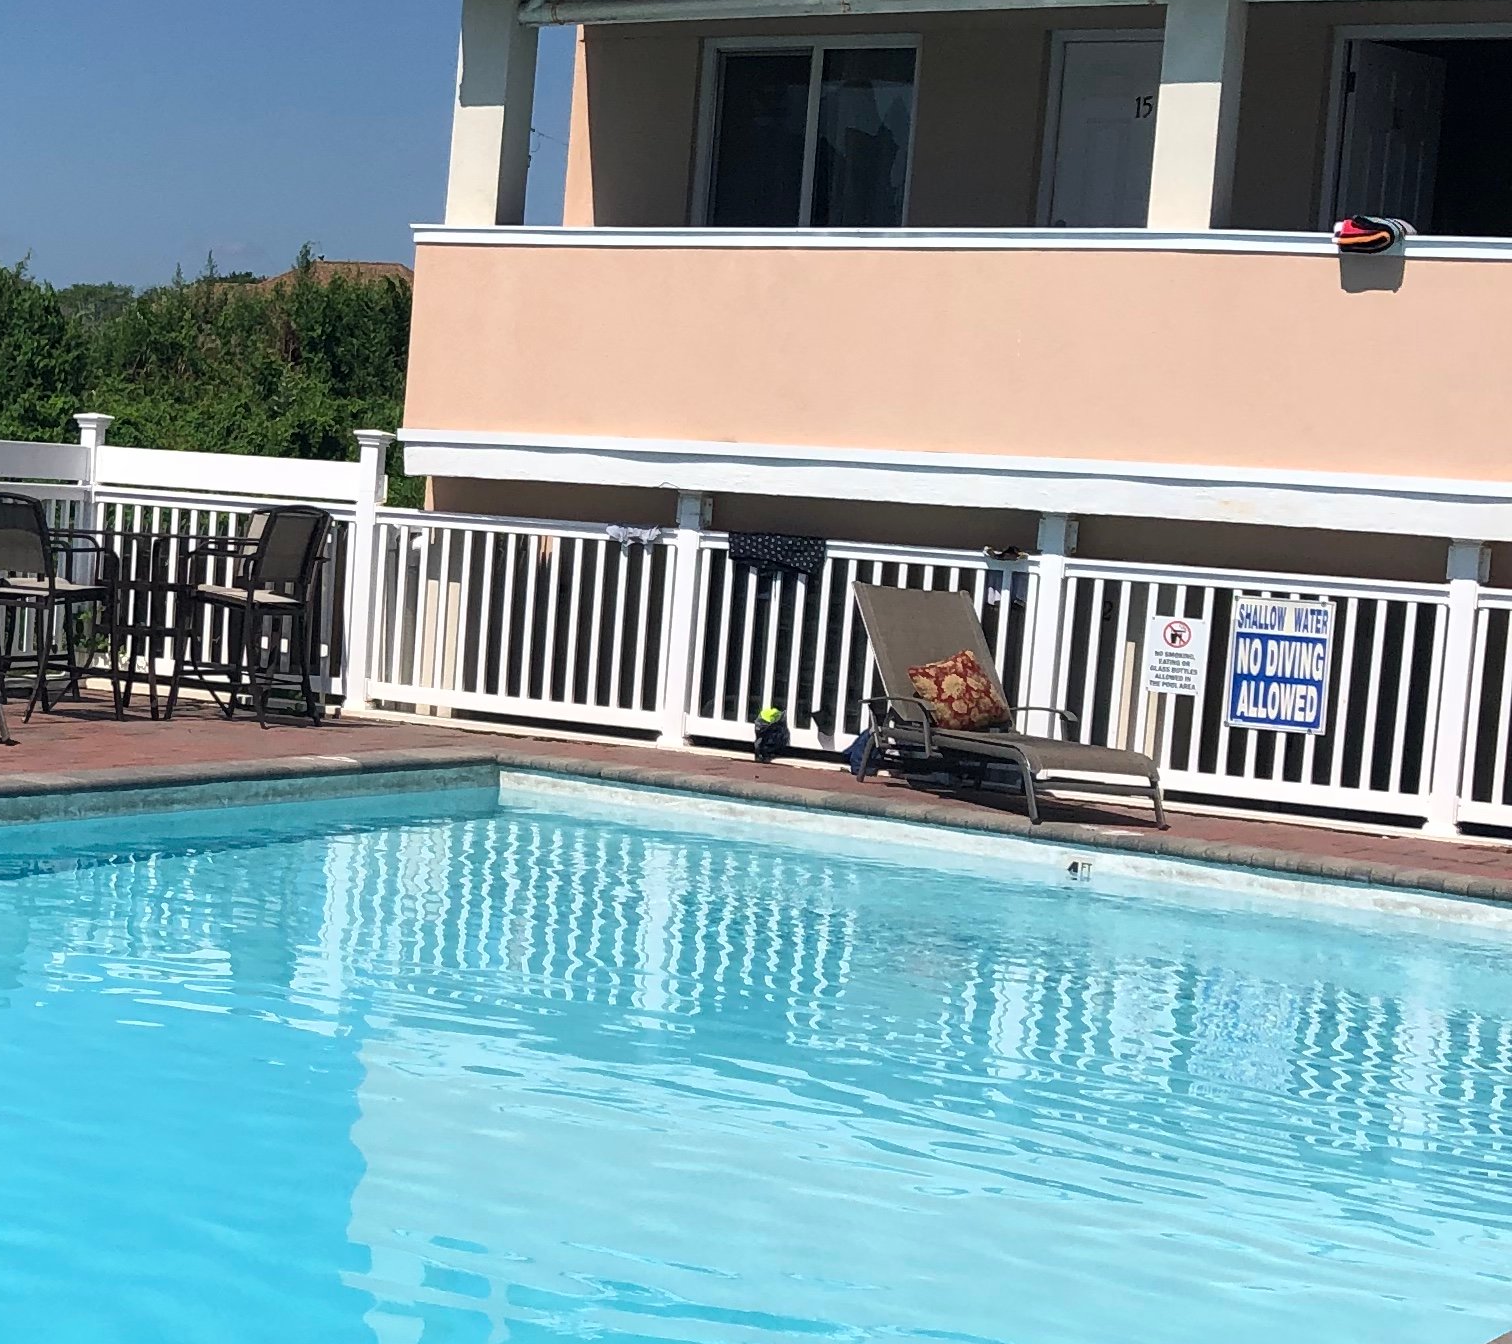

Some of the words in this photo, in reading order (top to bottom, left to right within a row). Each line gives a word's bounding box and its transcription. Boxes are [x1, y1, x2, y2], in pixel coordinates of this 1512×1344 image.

[1135, 95, 1154, 118] 15
[1237, 603, 1287, 632] SHALLOW
[1294, 607, 1329, 634] WATER
[1159, 658, 1181, 666] EATING
[1236, 637, 1263, 676] NO
[1265, 639, 1324, 681] DIVING
[1155, 673, 1183, 681] ALLOWED
[1171, 667, 1198, 675] BOTTLES
[1236, 679, 1318, 723] ALLOWED
